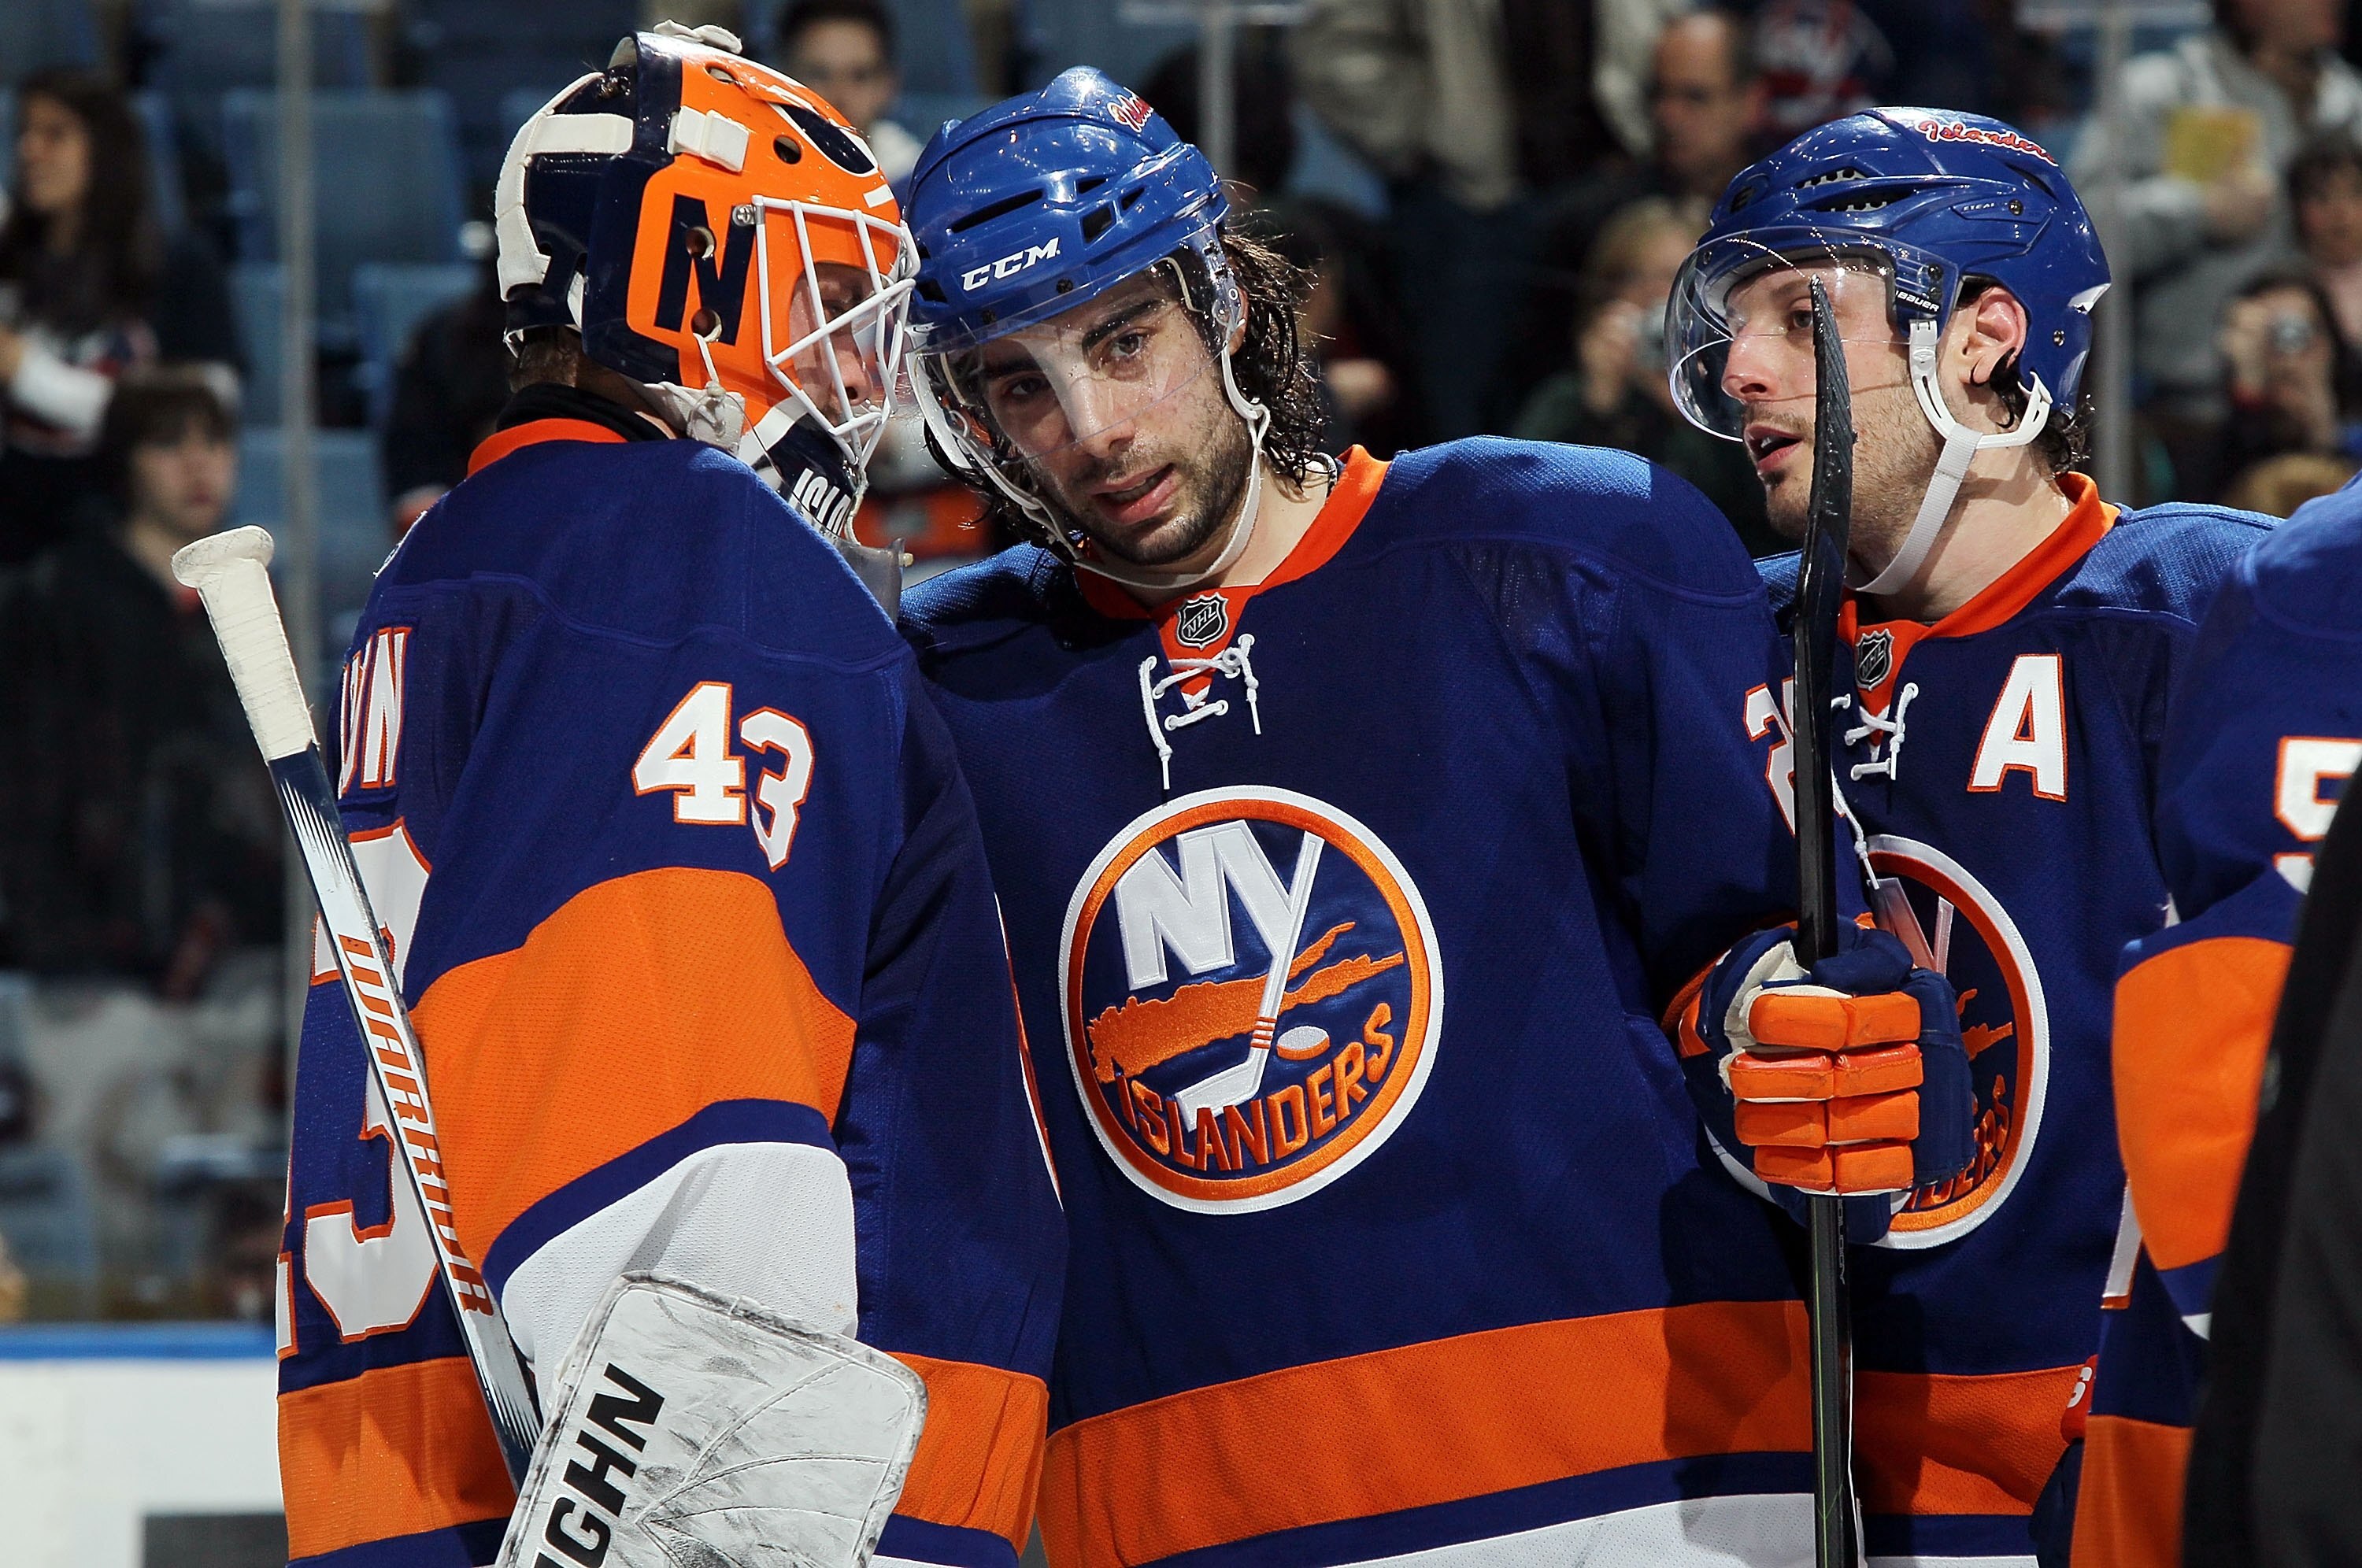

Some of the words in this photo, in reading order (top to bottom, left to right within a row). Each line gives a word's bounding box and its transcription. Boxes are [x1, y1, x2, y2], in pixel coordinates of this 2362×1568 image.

[653, 193, 760, 346] N
[961, 237, 1061, 291] CCM
[1897, 290, 1940, 312] BAUER
[1186, 605, 1216, 638] NHL
[1861, 645, 1885, 678] NHL
[632, 681, 815, 873] 43
[1968, 653, 2068, 803] A
[1114, 819, 1325, 1001] NY
[1115, 1001, 1393, 1171] ISLANDERS
[533, 1362, 666, 1568] GHN
